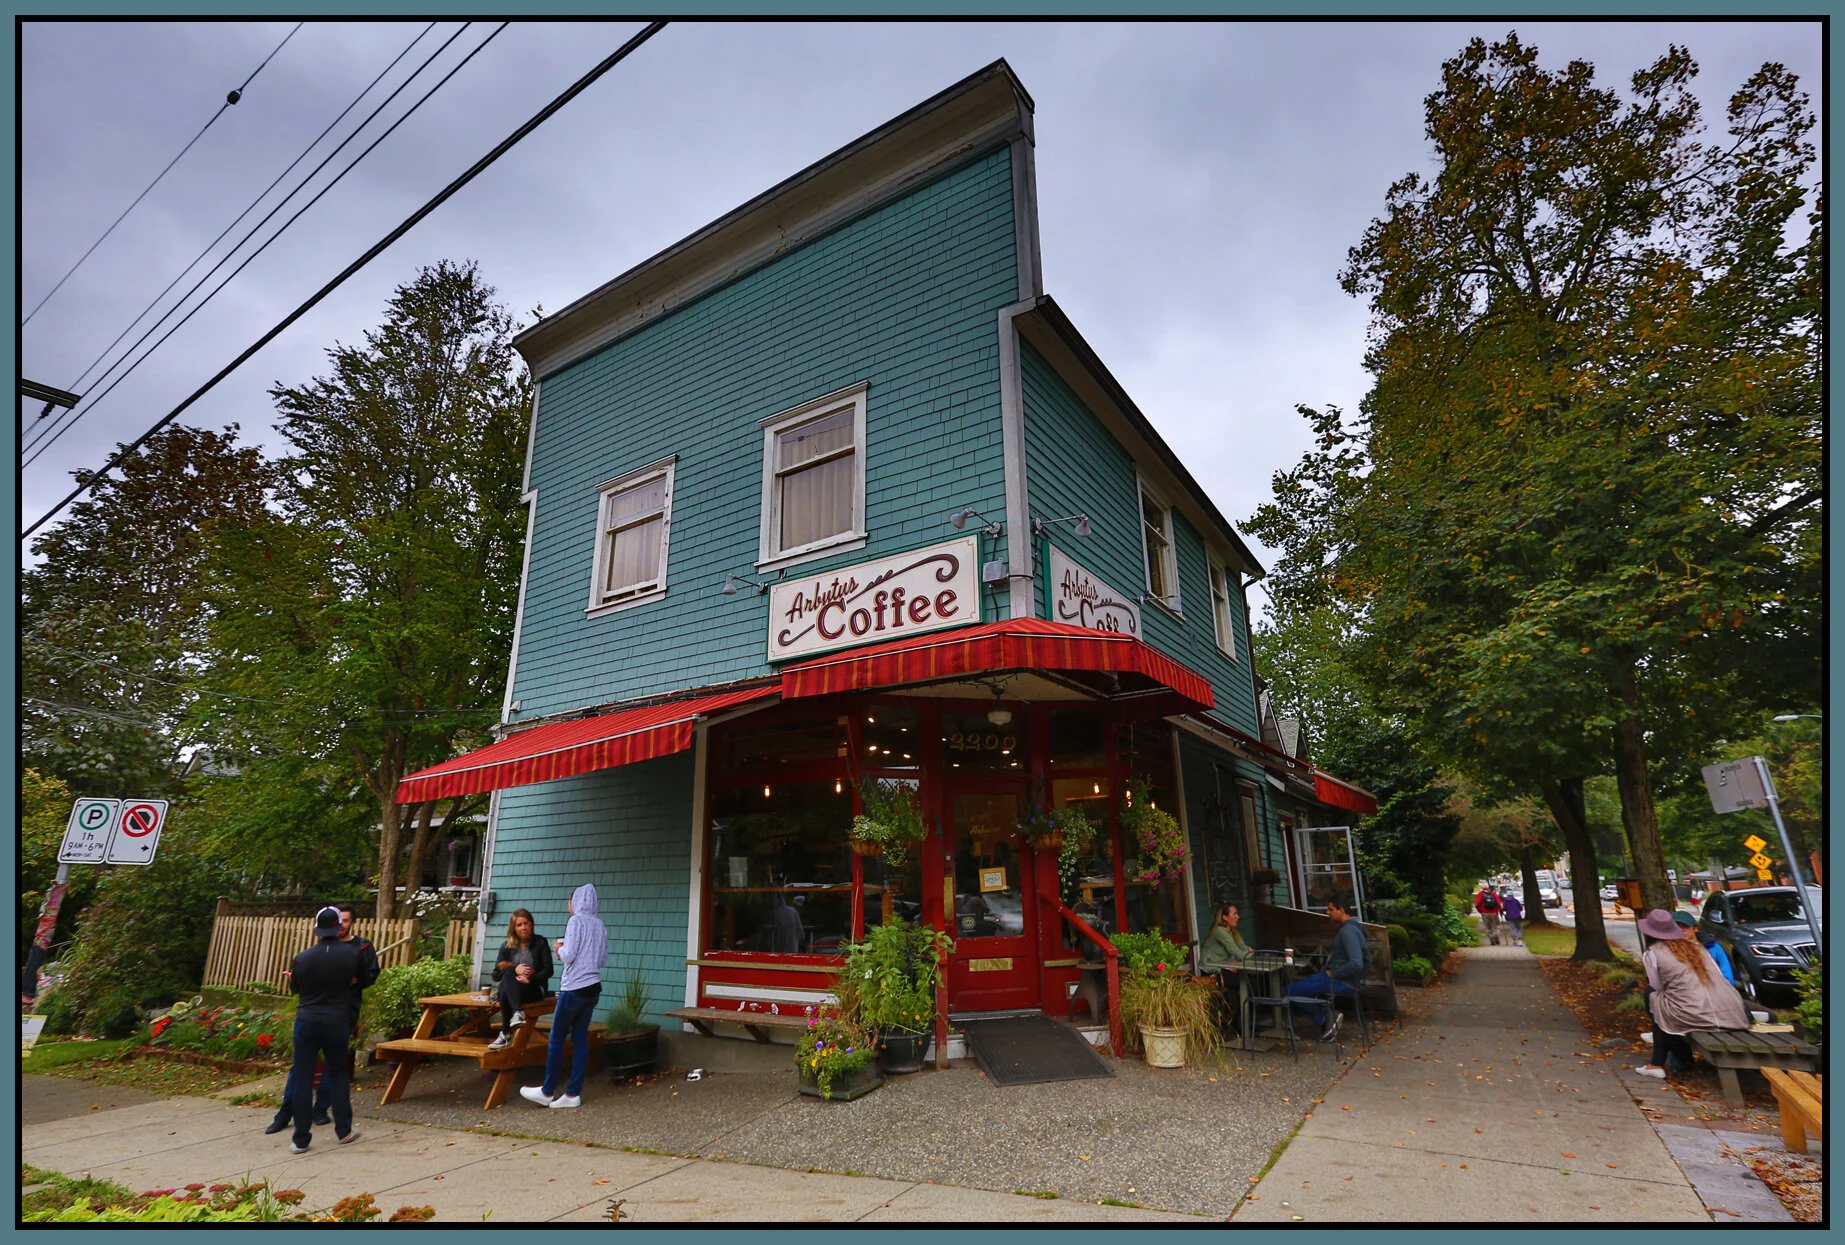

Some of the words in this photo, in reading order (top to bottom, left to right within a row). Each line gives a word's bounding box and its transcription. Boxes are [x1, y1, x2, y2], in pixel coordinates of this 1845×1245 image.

[785, 576, 859, 624] Arbutus
[1060, 568, 1099, 600] Arbutus
[816, 586, 960, 641] Coffee
[87, 809, 103, 824] P
